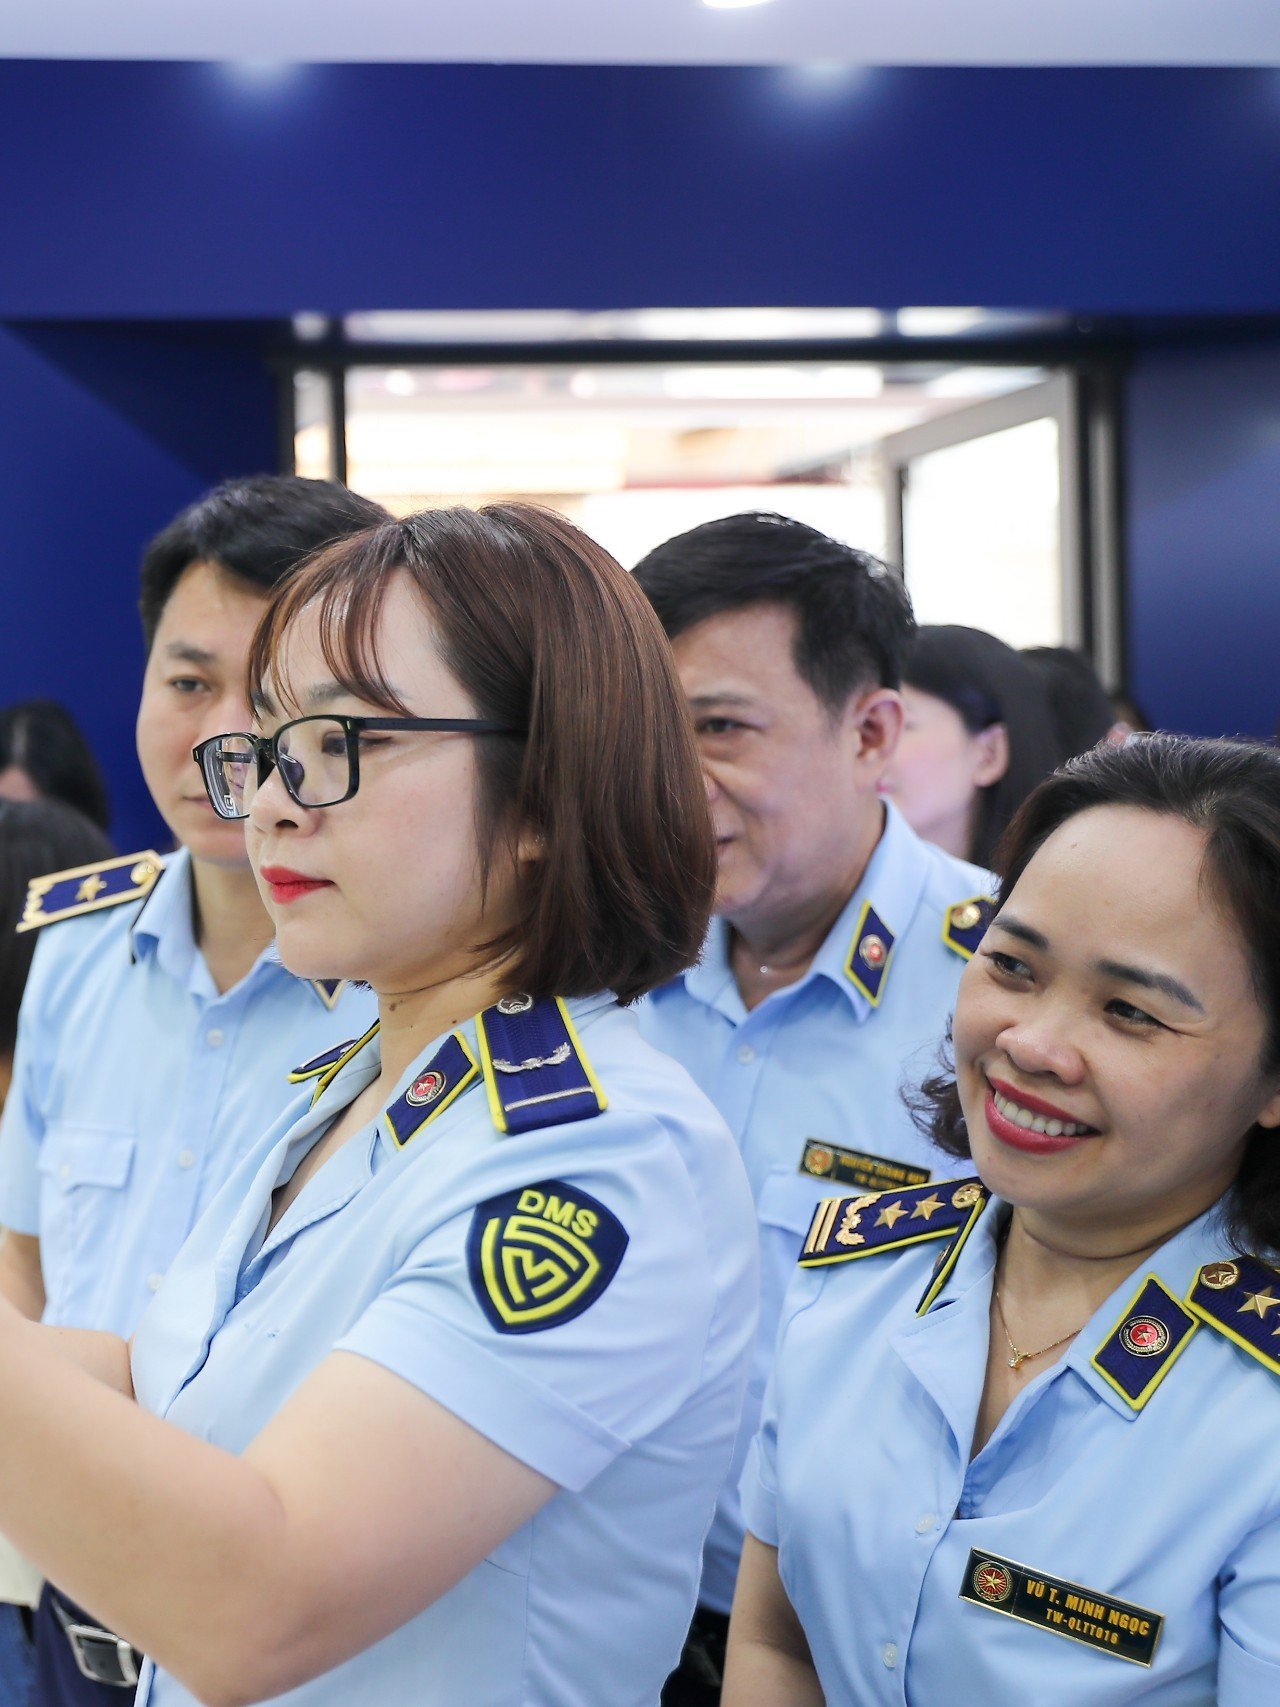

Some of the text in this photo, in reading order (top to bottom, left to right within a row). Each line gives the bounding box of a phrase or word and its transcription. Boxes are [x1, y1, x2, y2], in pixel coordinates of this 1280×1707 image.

[517, 1189, 599, 1238] DMS
[1026, 1579, 1151, 1636] VŨ T. MINH NGỌC
[1046, 1608, 1119, 1646] TW-QLTT016
